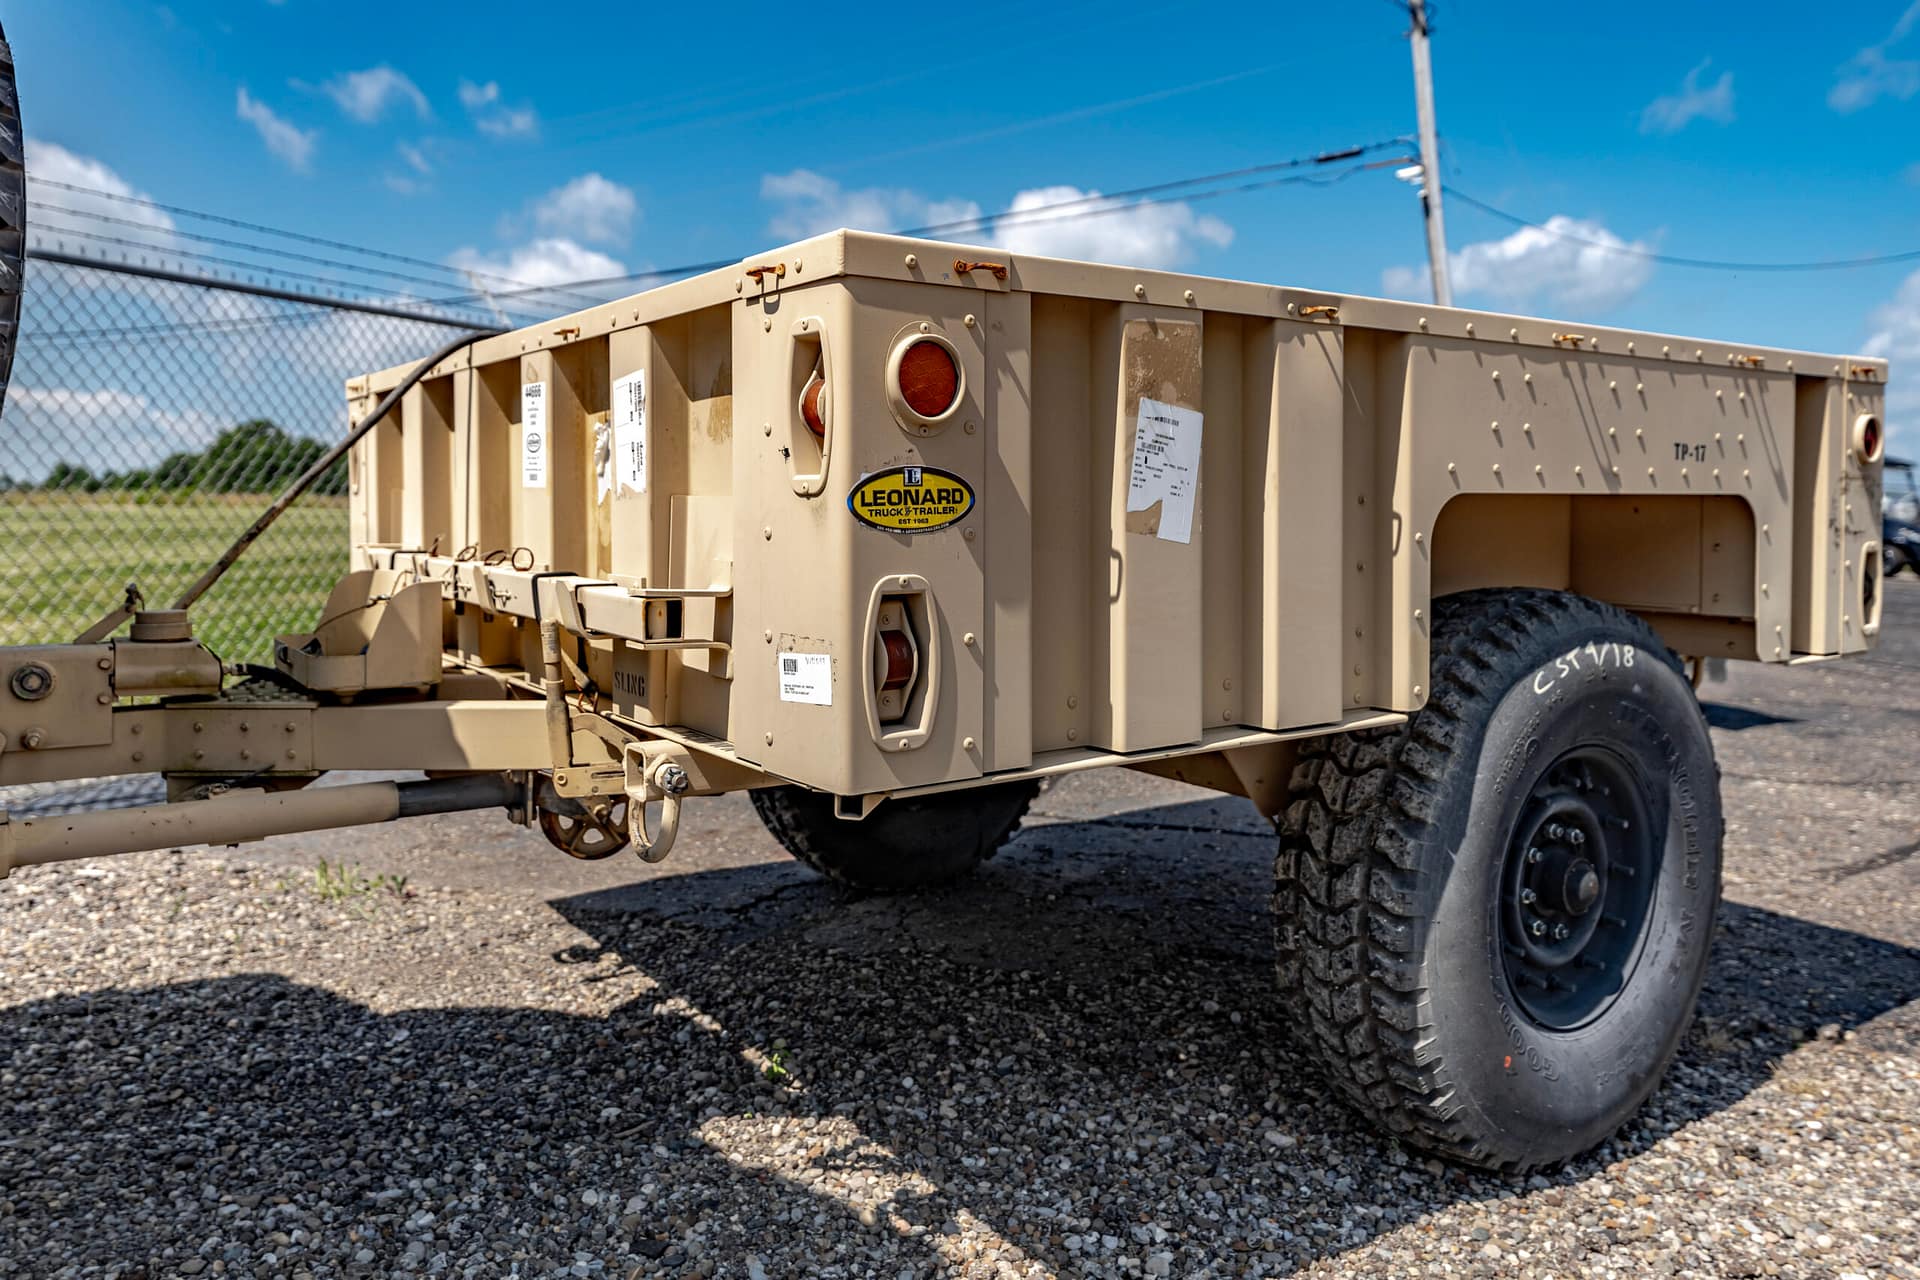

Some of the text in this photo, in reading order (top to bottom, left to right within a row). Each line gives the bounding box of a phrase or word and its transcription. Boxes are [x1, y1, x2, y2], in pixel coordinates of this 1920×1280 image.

[1674, 442, 1707, 462] TP-17
[860, 488, 964, 507] LEONARD
[868, 508, 903, 518] TRUCK
[912, 506, 955, 515] TRAILER
[614, 671, 646, 697] SLING
